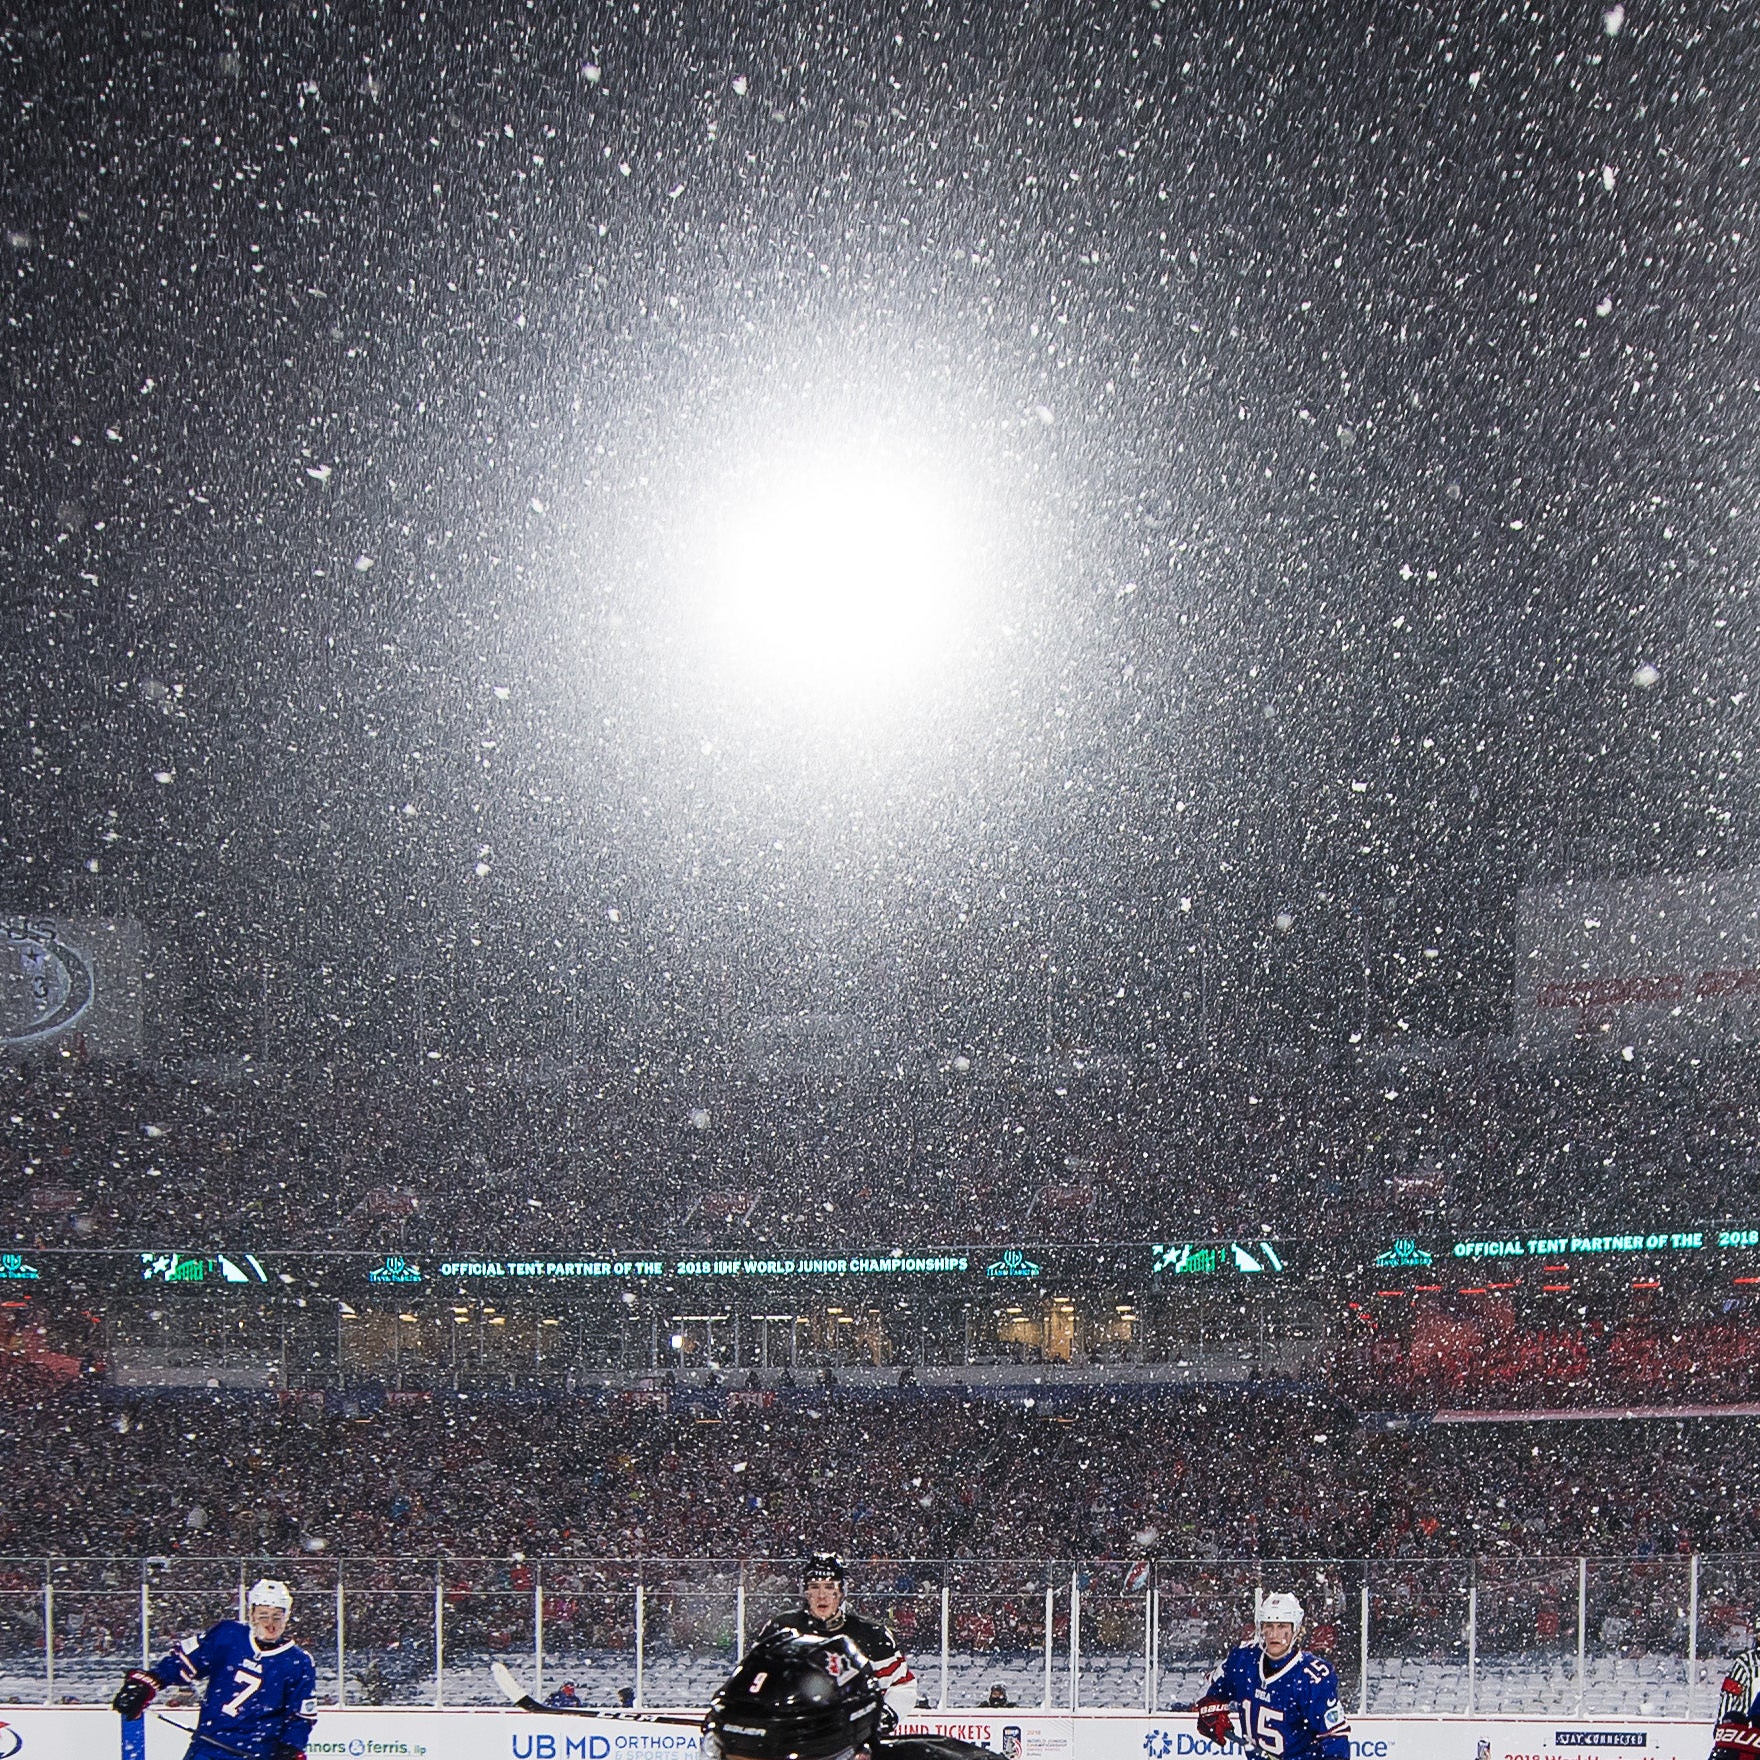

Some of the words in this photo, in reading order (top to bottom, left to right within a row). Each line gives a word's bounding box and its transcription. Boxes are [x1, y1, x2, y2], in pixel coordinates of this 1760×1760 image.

[1453, 1241, 1524, 1257] OFFICIAL
[1527, 1239, 1568, 1255] TENT
[1570, 1235, 1643, 1252] PARTNER
[1646, 1234, 1669, 1250] OF
[1670, 1232, 1703, 1249] THE
[1719, 1230, 1758, 1247] 2018
[441, 1262, 505, 1275] OFFICIAL
[507, 1262, 543, 1275] TENT
[546, 1262, 611, 1276] PARTNER
[613, 1262, 632, 1275] OF
[634, 1261, 663, 1275] THE
[677, 1261, 711, 1274] 2018
[714, 1261, 740, 1274] IIHF
[744, 1261, 794, 1274] WORLD
[797, 1260, 847, 1274] JUNIOR
[849, 1257, 968, 1273] CHAMPIONSHIPS
[1303, 1660, 1331, 1685] 15
[750, 1672, 769, 1694] 9
[221, 1669, 263, 1719] 7
[595, 1710, 660, 1723] CCM
[934, 1724, 991, 1741] TICKETS
[1242, 1699, 1285, 1756] 15
[303, 1742, 346, 1754] nnors
[626, 1751, 679, 1760] SPORTS
